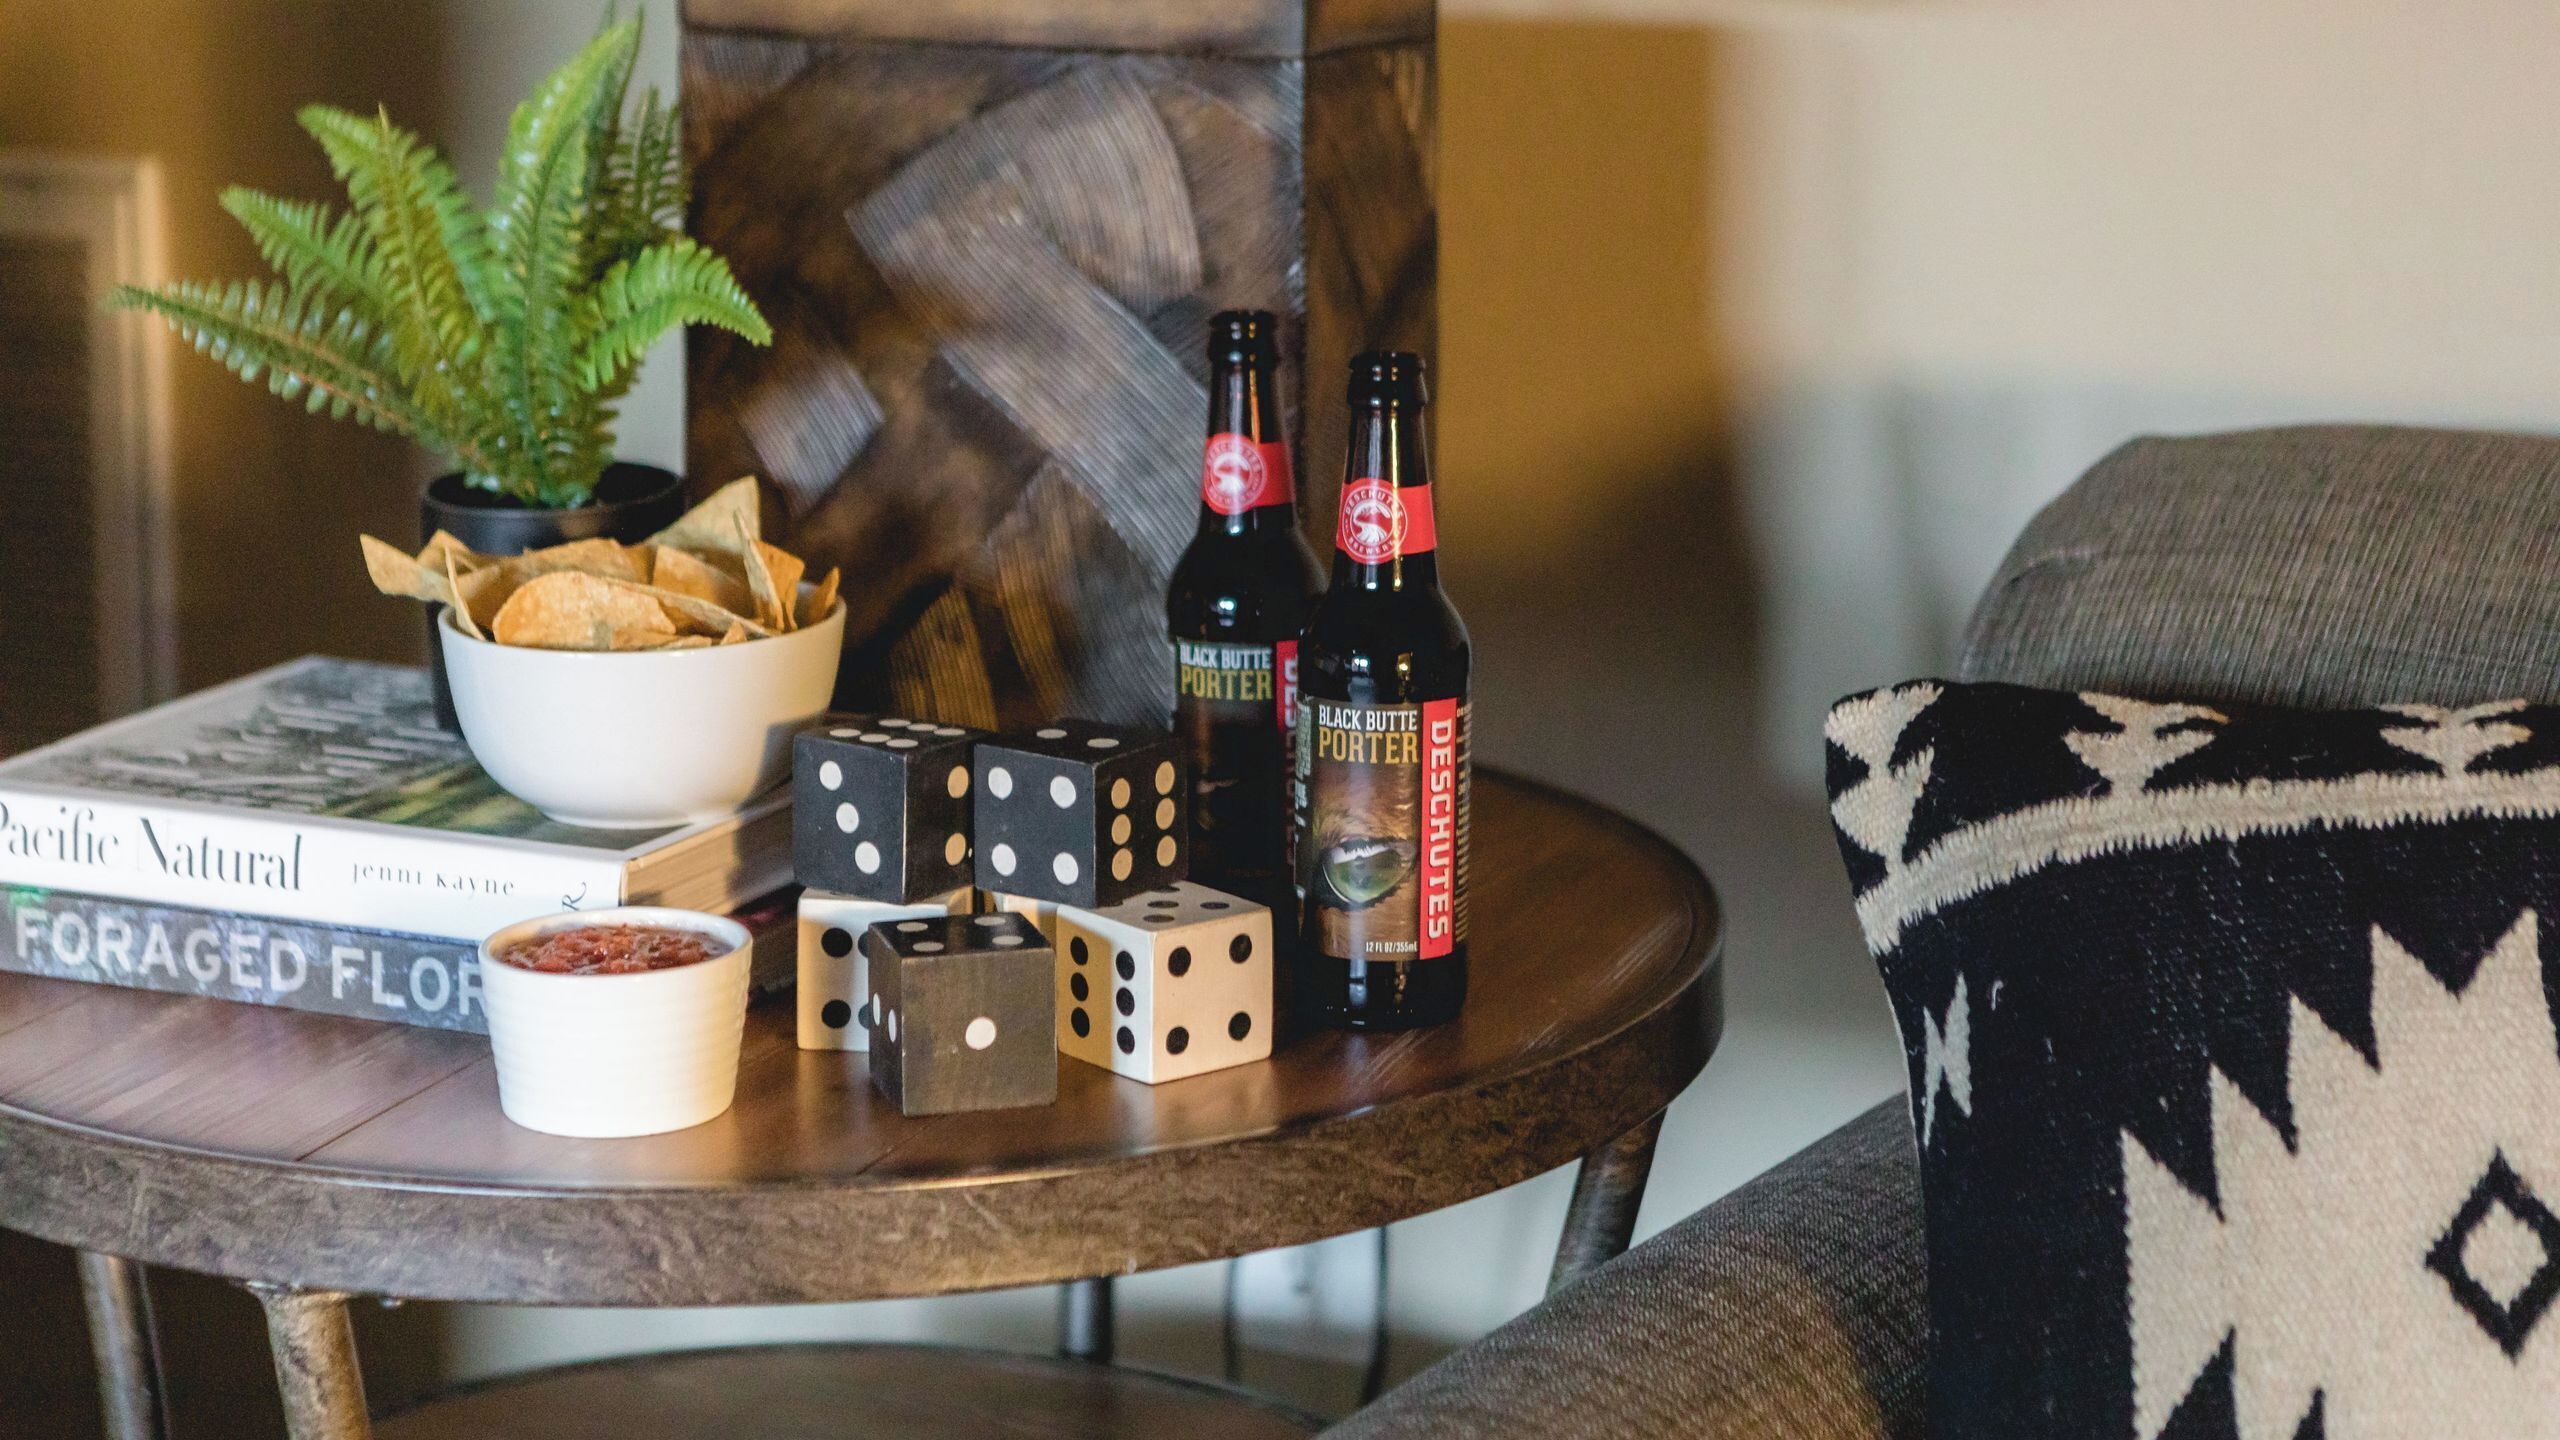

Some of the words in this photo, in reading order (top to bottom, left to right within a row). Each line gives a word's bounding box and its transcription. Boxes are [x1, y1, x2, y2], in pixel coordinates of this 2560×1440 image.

[1345, 487, 1403, 517] DESCHUT
[1180, 643, 1217, 668] BLACK
[1221, 648, 1271, 669] BUTTE
[1181, 664, 1272, 700] PORTER
[1319, 704, 1361, 730] BLACK
[1366, 710, 1417, 732] BUTTE
[1319, 727, 1418, 764] PORTER
[1428, 719, 1452, 939] DESCHUTES
[137, 816, 302, 890] Natural
[15, 906, 308, 993] FORAGED
[1366, 942, 1373, 952] 12
[1376, 942, 1383, 952] FL
